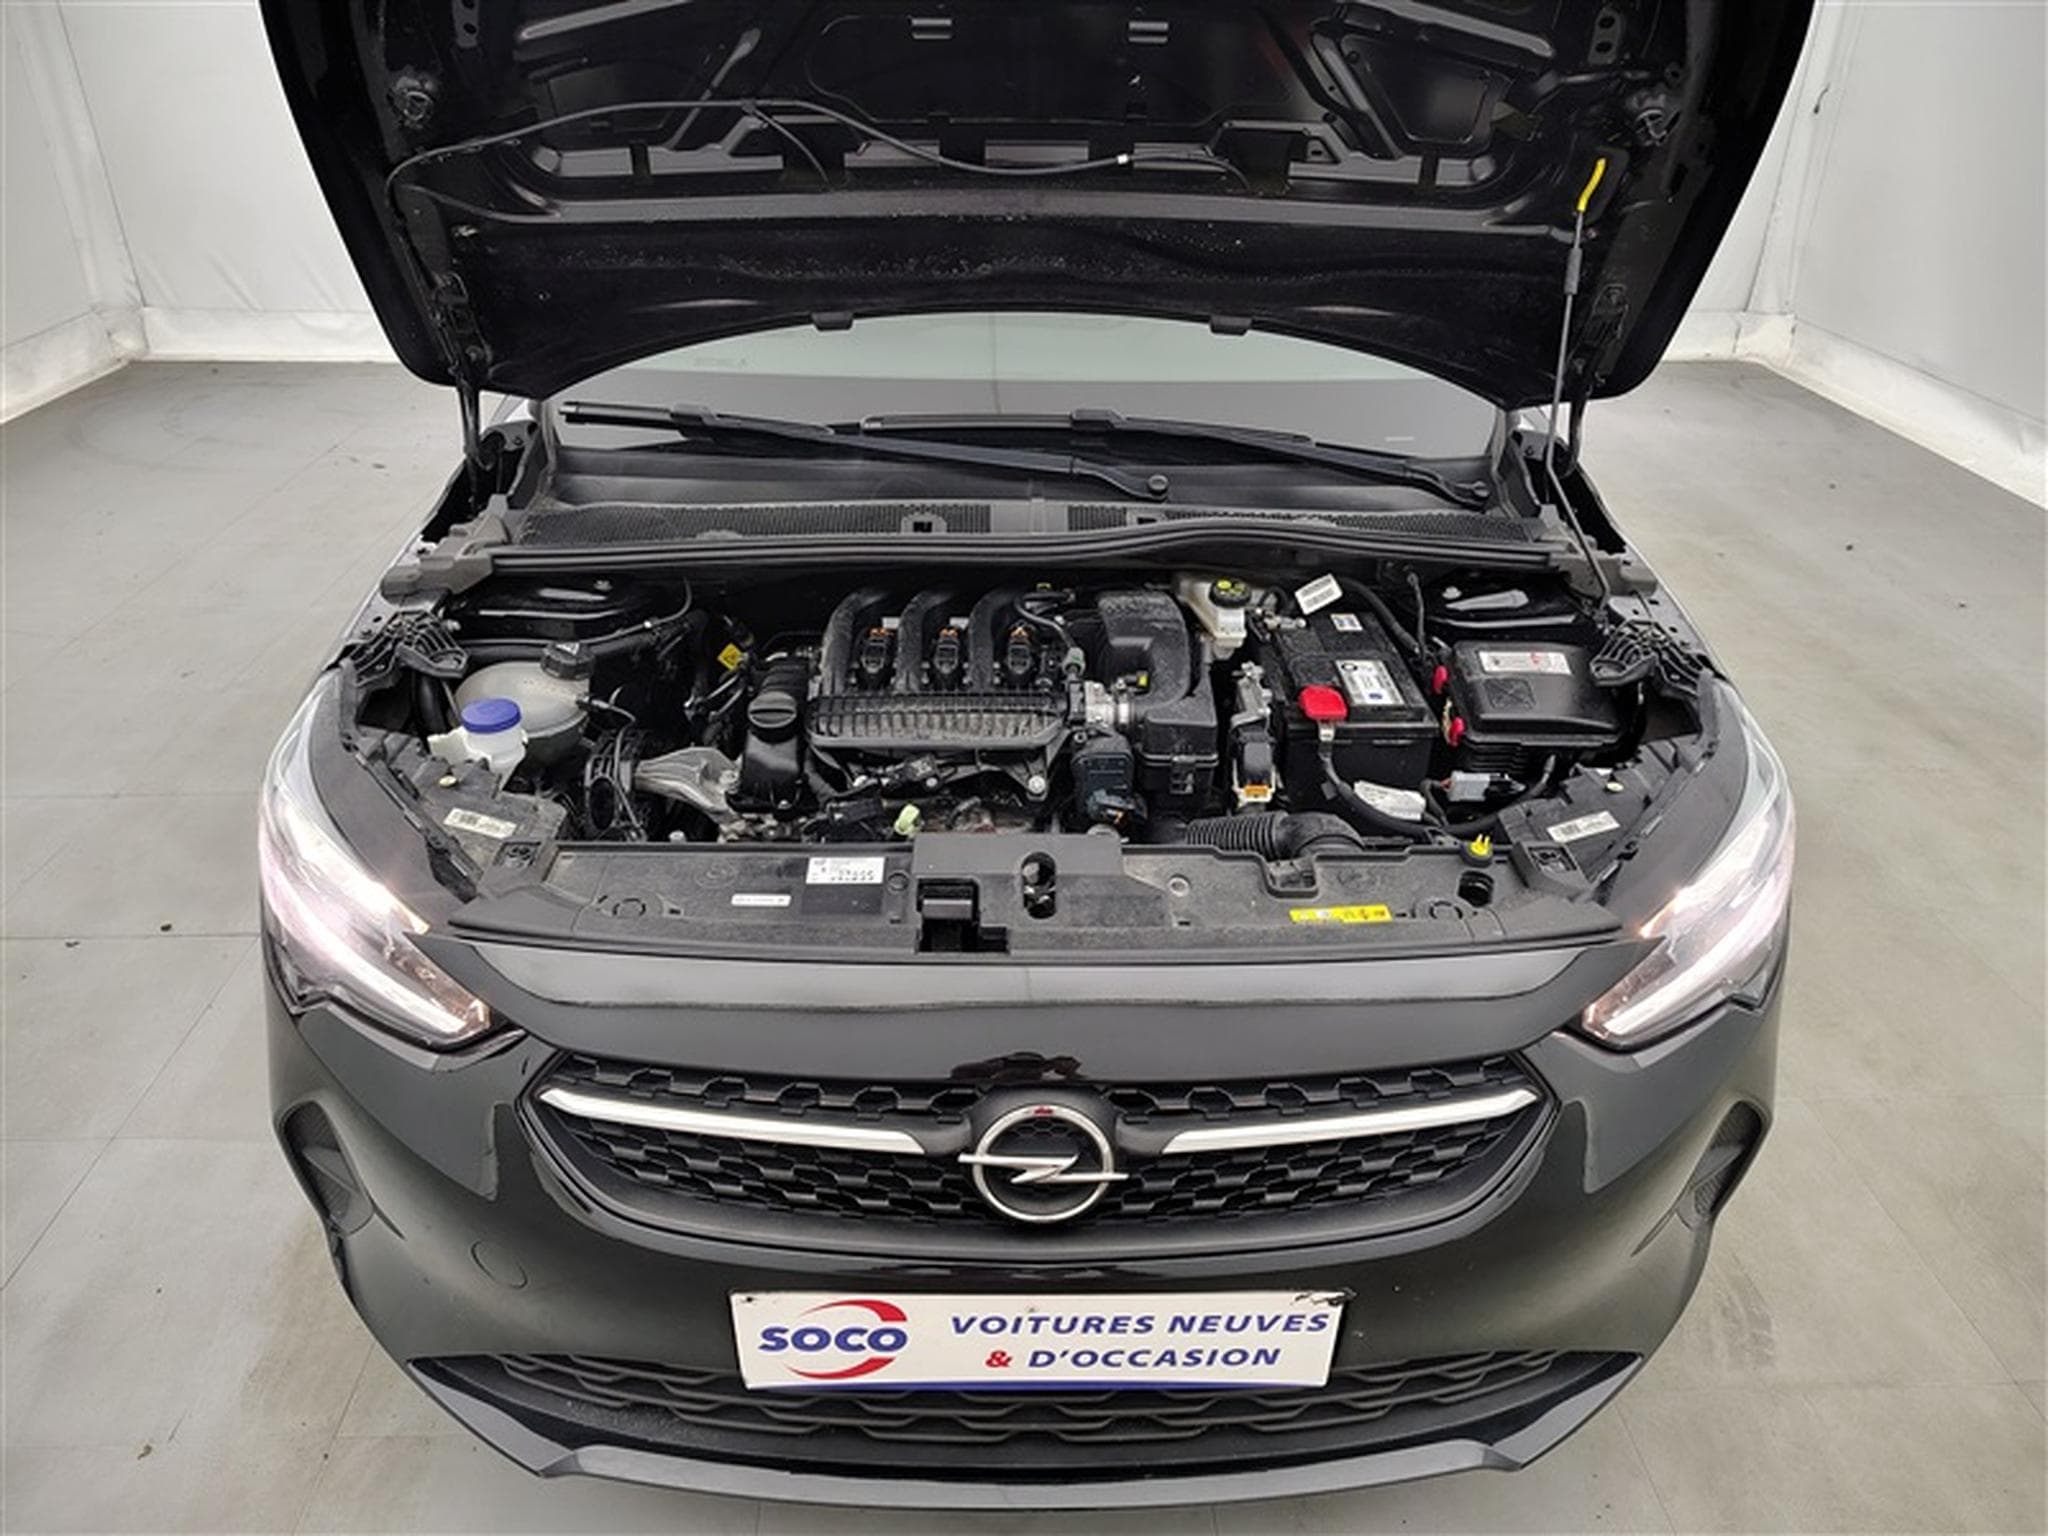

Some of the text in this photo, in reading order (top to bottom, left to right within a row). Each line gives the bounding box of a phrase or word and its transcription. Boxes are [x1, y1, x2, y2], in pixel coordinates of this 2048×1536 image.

[951, 1313, 1330, 1335] VOITURES NEUVES
[758, 1326, 908, 1352] SOCO
[984, 1348, 1281, 1368] & D'OCCASION
